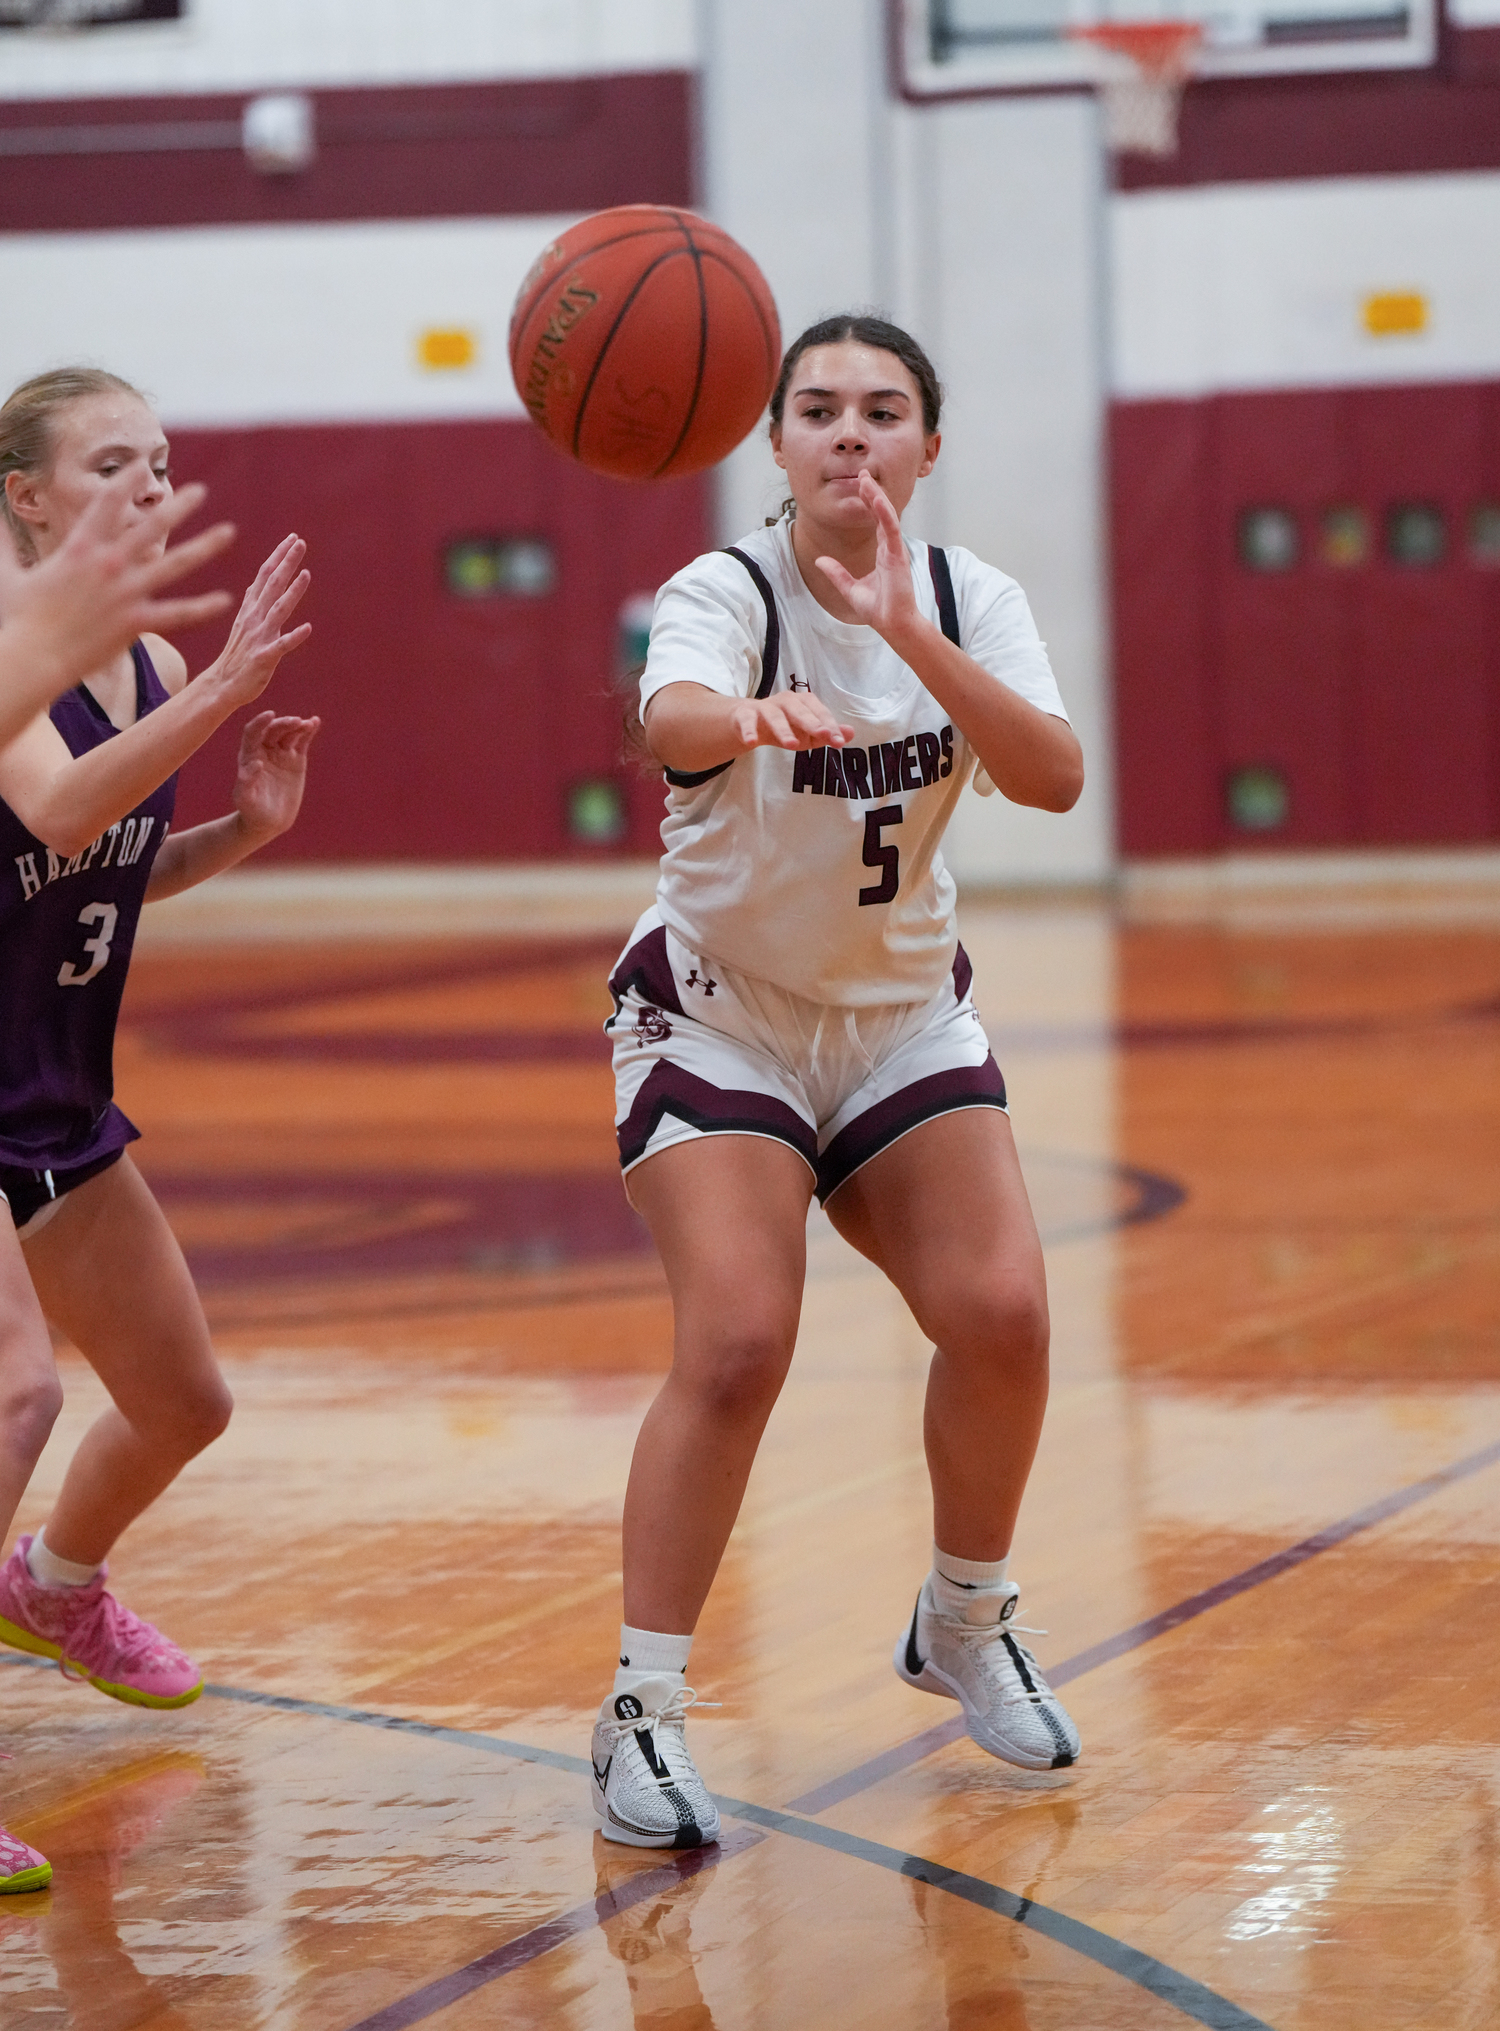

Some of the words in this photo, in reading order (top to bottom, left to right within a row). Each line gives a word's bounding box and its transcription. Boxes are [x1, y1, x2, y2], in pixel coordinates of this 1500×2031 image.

[792, 724, 954, 800] MARINERS
[858, 804, 904, 907] 5
[56, 901, 119, 987] 3
